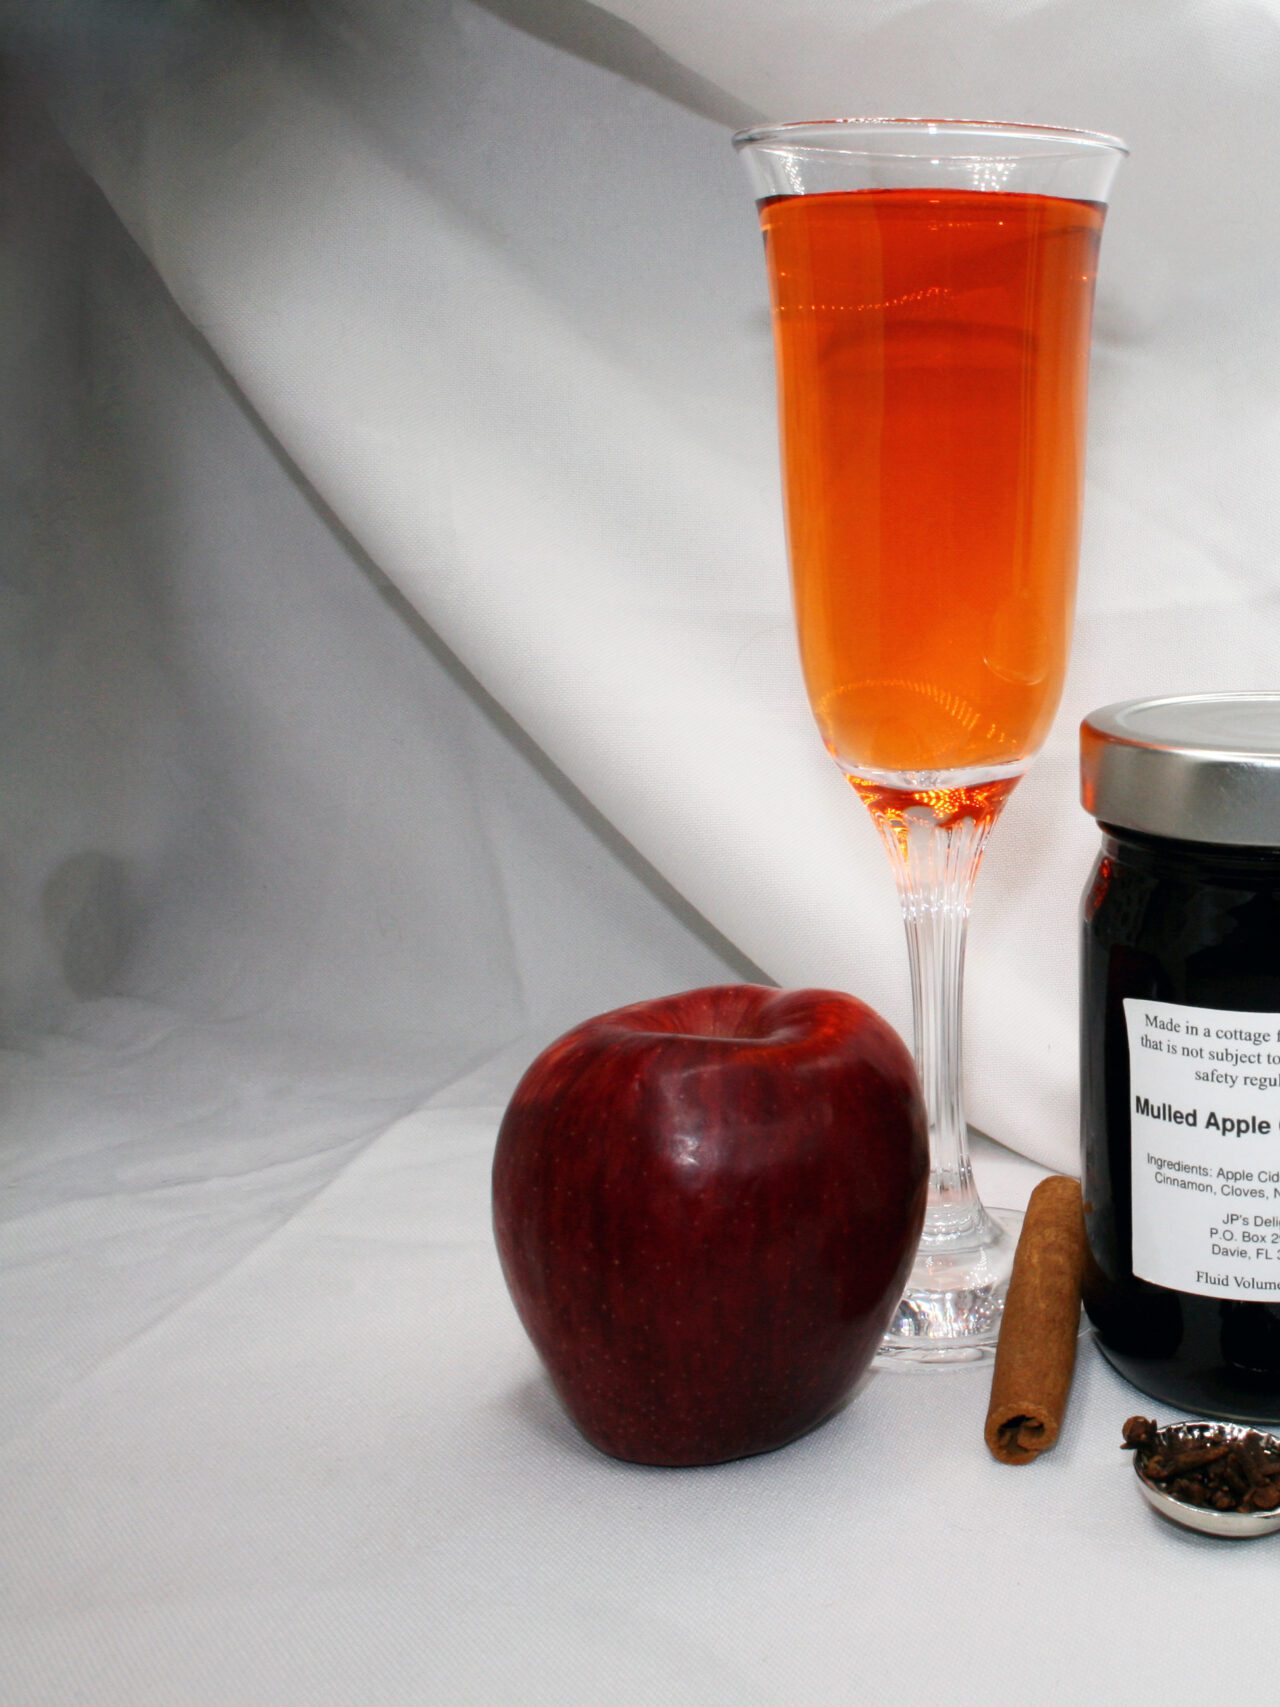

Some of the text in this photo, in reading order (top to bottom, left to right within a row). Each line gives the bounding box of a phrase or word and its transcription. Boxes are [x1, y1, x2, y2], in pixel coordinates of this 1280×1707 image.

[1144, 1013, 1181, 1033] Made
[1186, 1020, 1198, 1036] in
[1203, 1027, 1211, 1038] a
[1215, 1027, 1270, 1046] cottage
[1140, 1034, 1163, 1051] that
[1167, 1040, 1177, 1055] is
[1181, 1046, 1204, 1059] not
[1208, 1047, 1262, 1067] subject
[1194, 1068, 1238, 1089] safety
[1135, 1096, 1198, 1127] Mulled
[1205, 1111, 1271, 1138] Apple
[1147, 1152, 1213, 1177] Ingredients:
[1216, 1167, 1254, 1183] Apple
[1154, 1171, 1217, 1195] Cinnamon,
[1220, 1184, 1269, 1200] Cloves,
[1222, 1213, 1250, 1226] JP's
[1209, 1227, 1238, 1242] P.O.
[1241, 1230, 1267, 1243] Box
[1211, 1243, 1251, 1260] Davie,
[1256, 1248, 1273, 1260] FL
[1196, 1270, 1230, 1287] Fluid
